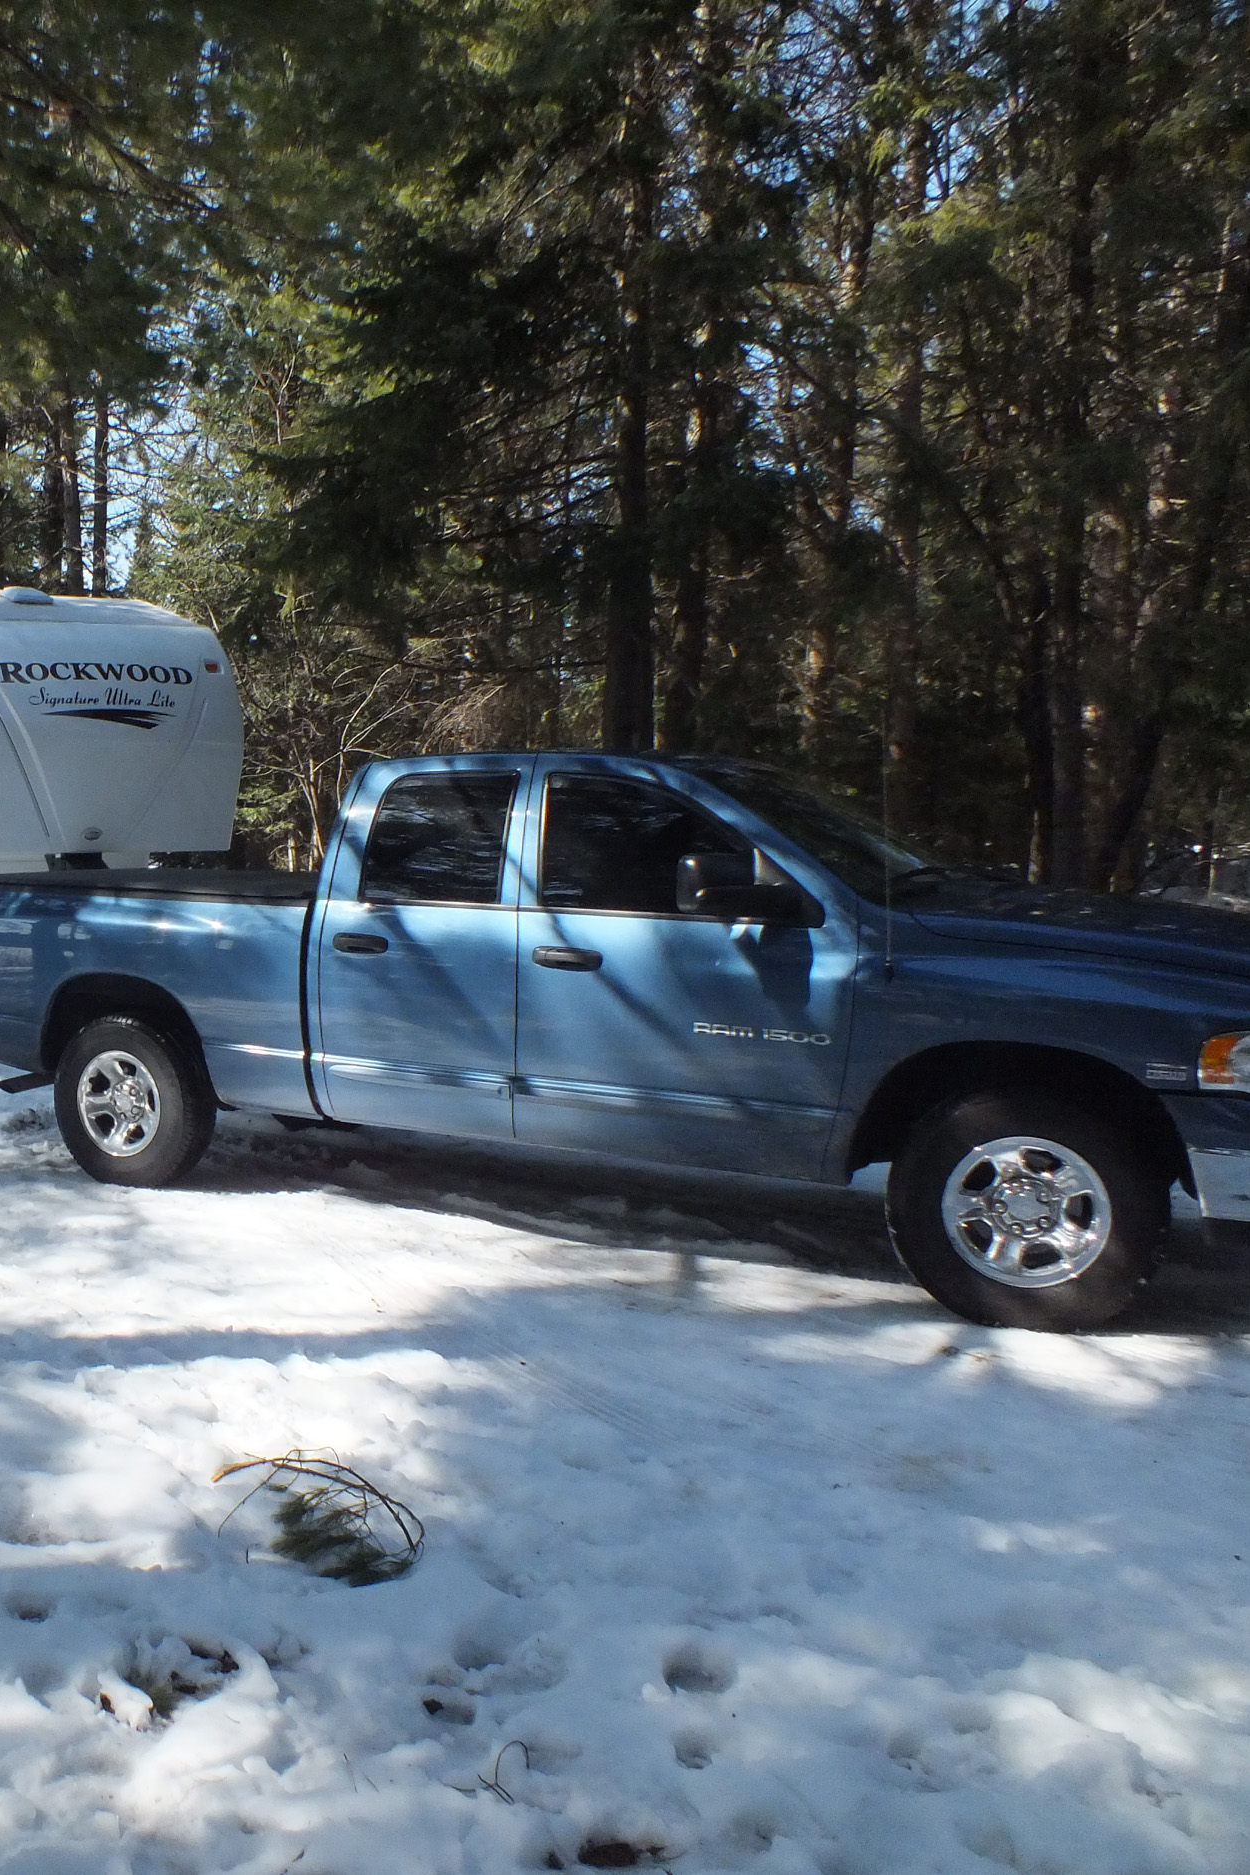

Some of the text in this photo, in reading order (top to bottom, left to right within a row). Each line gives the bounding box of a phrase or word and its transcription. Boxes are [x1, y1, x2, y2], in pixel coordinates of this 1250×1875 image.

[28, 687, 176, 708] Signature Ultra Lite
[693, 1021, 832, 1046] RAM 1500
